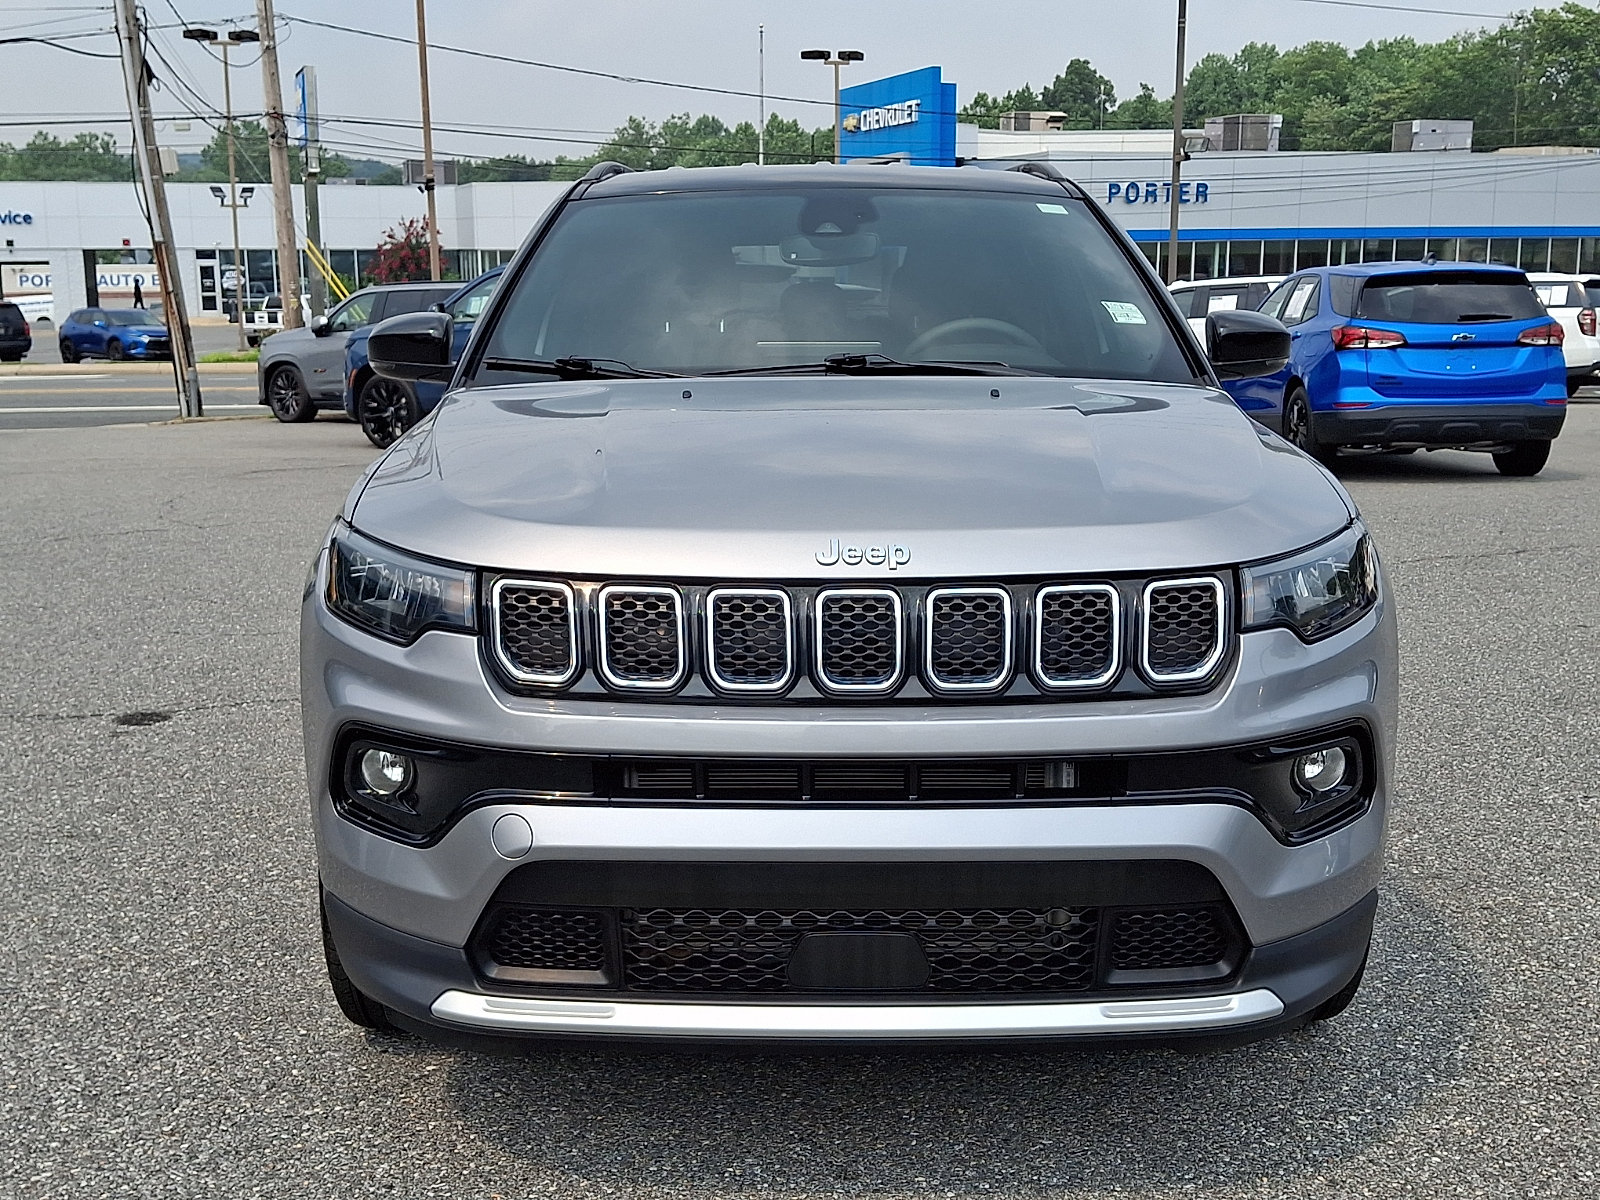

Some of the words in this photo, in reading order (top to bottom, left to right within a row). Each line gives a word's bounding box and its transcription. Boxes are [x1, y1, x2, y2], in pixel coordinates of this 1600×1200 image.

[861, 99, 920, 131] CHEVROLET
[1107, 182, 1208, 204] PORTER
[97, 274, 145, 286] AUTO
[815, 538, 911, 570] Jeep
